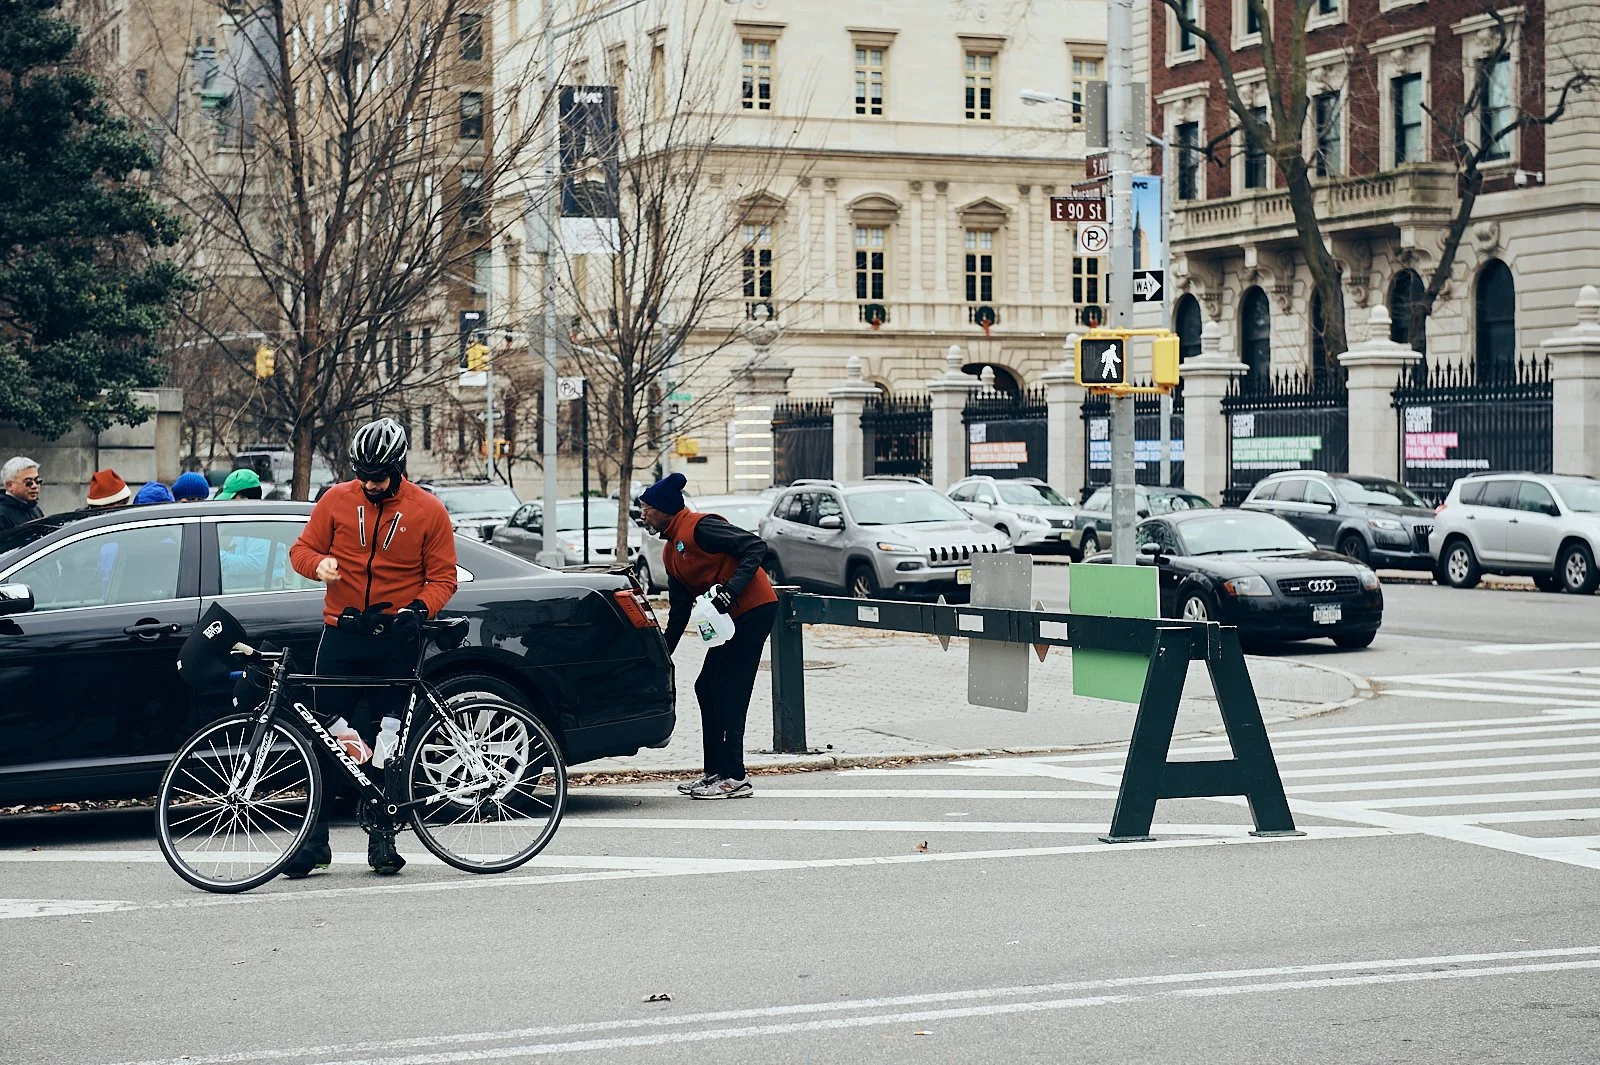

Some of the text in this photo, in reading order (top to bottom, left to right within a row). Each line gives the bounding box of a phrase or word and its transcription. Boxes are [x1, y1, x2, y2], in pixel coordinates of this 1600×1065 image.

[1056, 203, 1102, 220] E 90 St
[1136, 281, 1155, 293] WAY
[293, 702, 372, 787] cannondale
